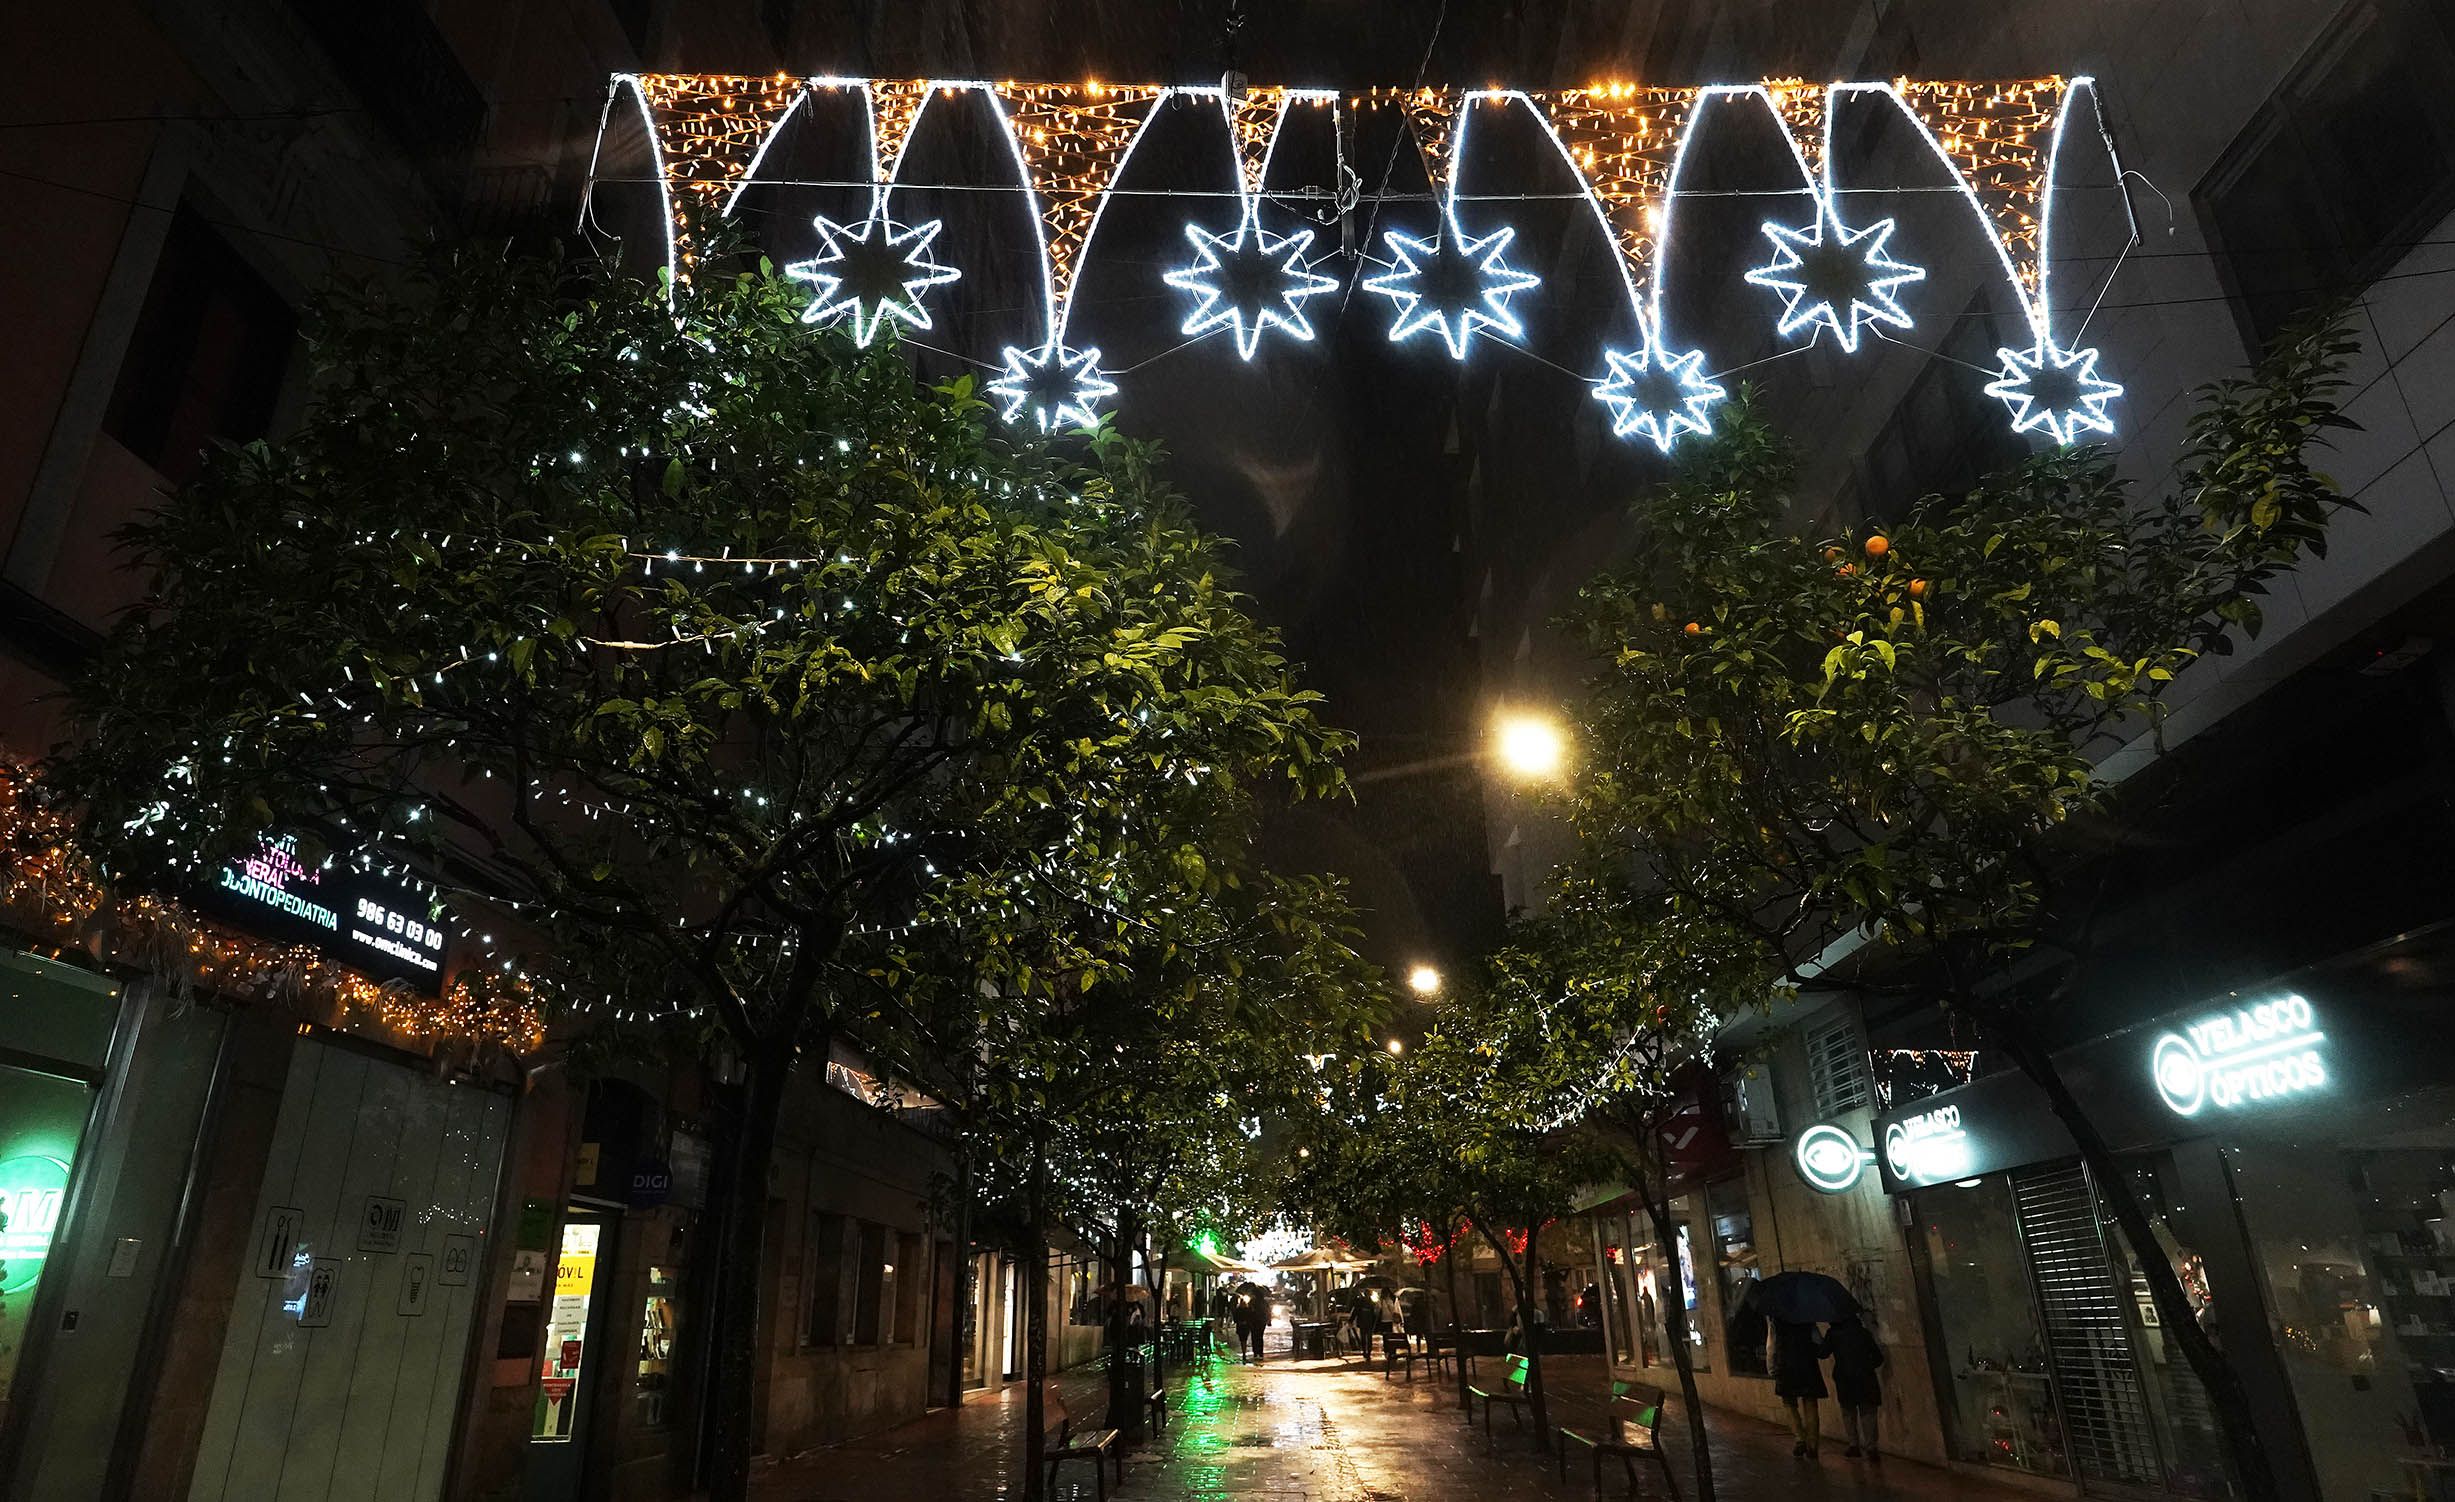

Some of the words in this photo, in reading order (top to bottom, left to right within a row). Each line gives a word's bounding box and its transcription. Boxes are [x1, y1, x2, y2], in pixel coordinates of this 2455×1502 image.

[356, 897, 386, 926] 986
[386, 911, 405, 934] 63
[405, 920, 424, 943] 03
[424, 928, 443, 951] 00
[2188, 994, 2312, 1057] VELASCO
[632, 1175, 669, 1189] DIGI
